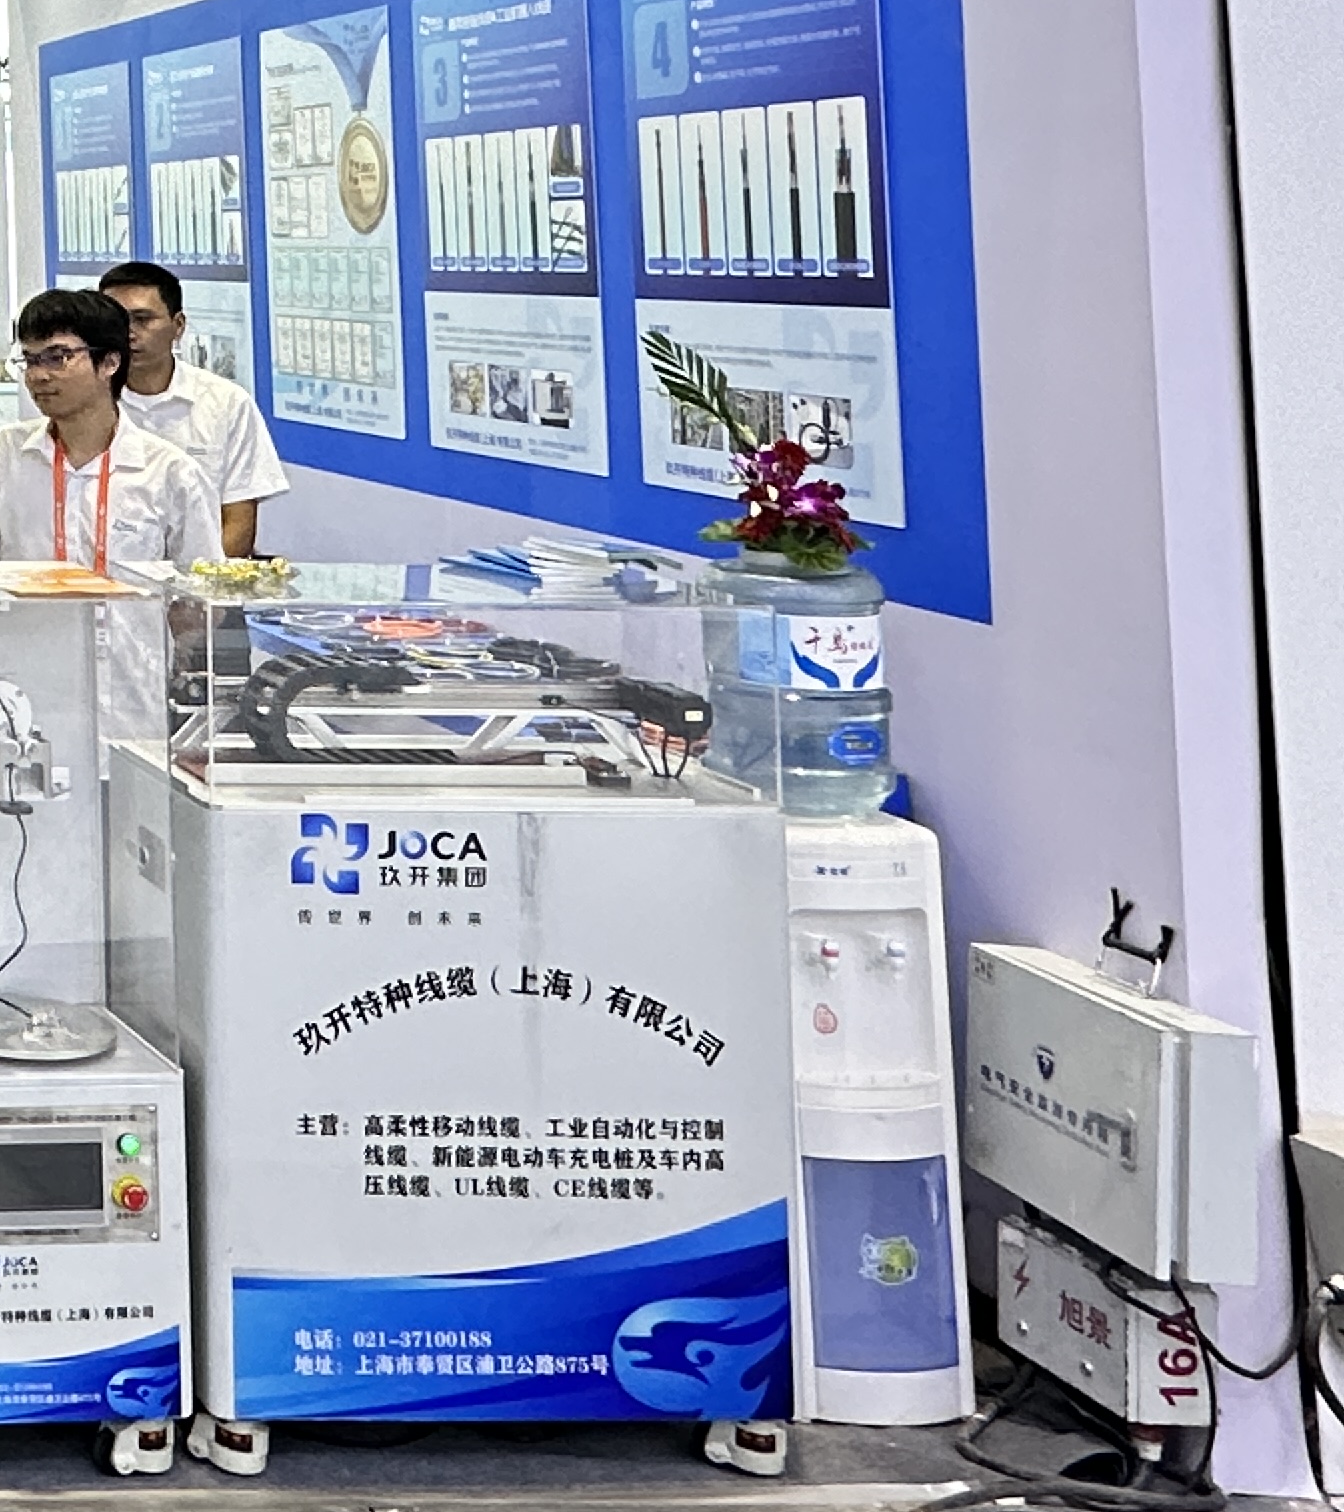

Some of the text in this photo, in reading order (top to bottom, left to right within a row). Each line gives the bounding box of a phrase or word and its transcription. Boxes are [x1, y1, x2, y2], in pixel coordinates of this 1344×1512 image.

[651, 20, 672, 78] 4
[432, 57, 449, 108] 3
[378, 829, 487, 861] JOCA
[379, 865, 487, 888] 玖开集团
[292, 965, 726, 1068] 玖开特种线缆（上海）有限公司
[364, 1115, 725, 1141] 高柔性移动线缆、工业自动化与控制
[364, 1145, 725, 1172] 线缆、新能源电动车充电桩及车内高
[353, 1330, 492, 1349] 021-37100188
[1058, 1290, 1113, 1350] 旭景
[1156, 1304, 1200, 1408] 16A
